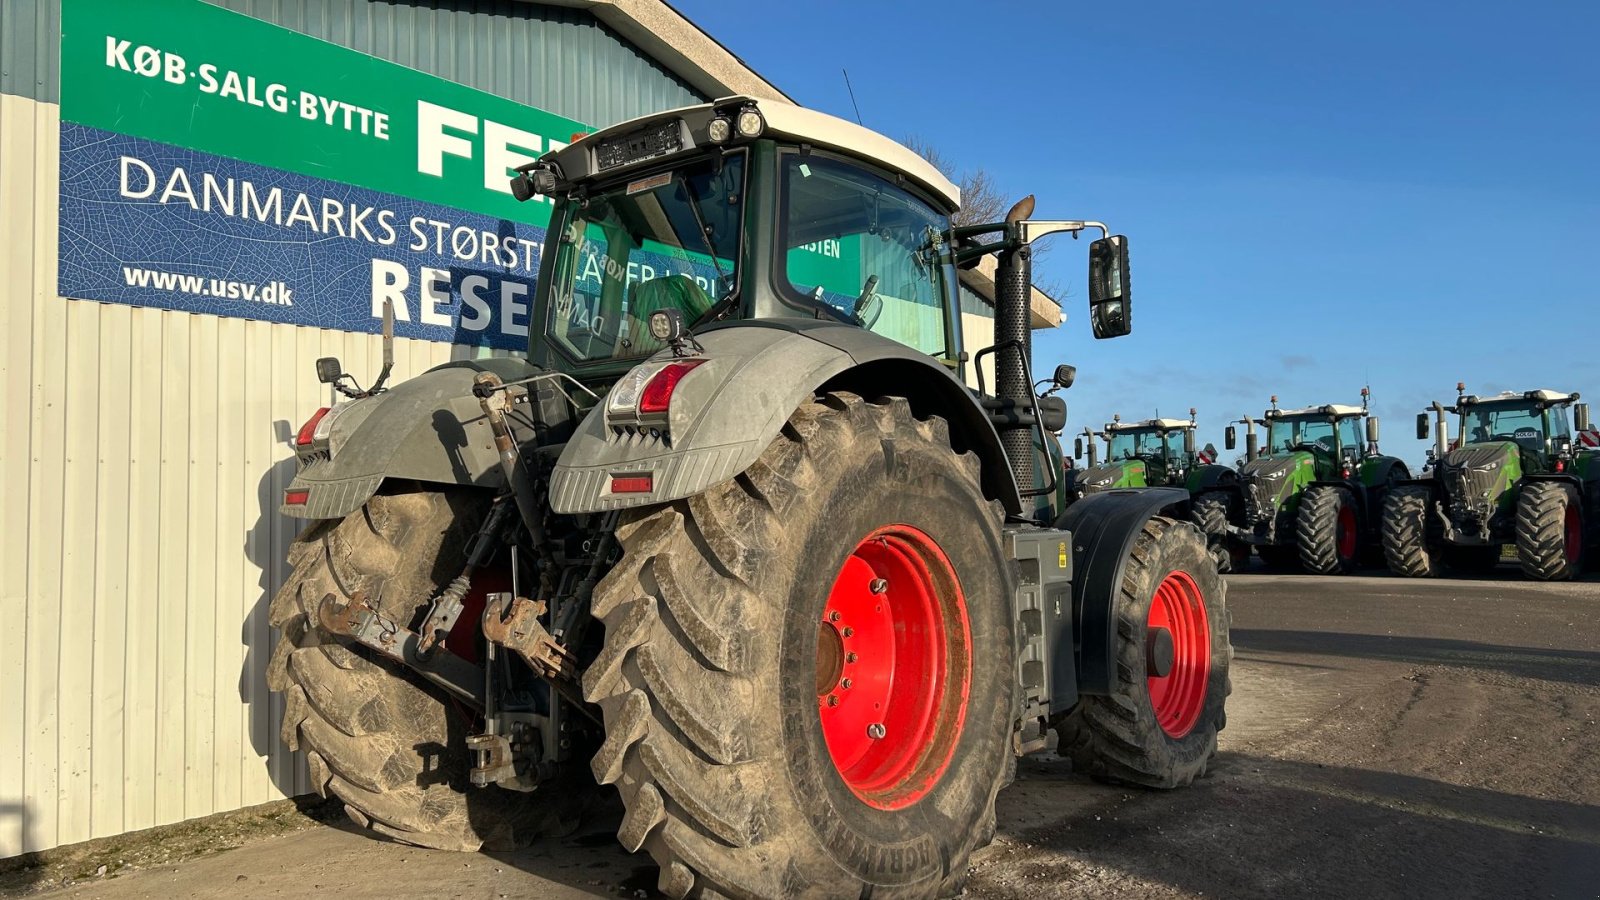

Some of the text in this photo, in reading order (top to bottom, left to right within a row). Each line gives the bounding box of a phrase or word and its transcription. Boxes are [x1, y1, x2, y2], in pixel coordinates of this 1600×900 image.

[120, 155, 396, 246] DANMARKS
[409, 216, 544, 272] STØRST
[123, 266, 293, 306] www.usv.dk
